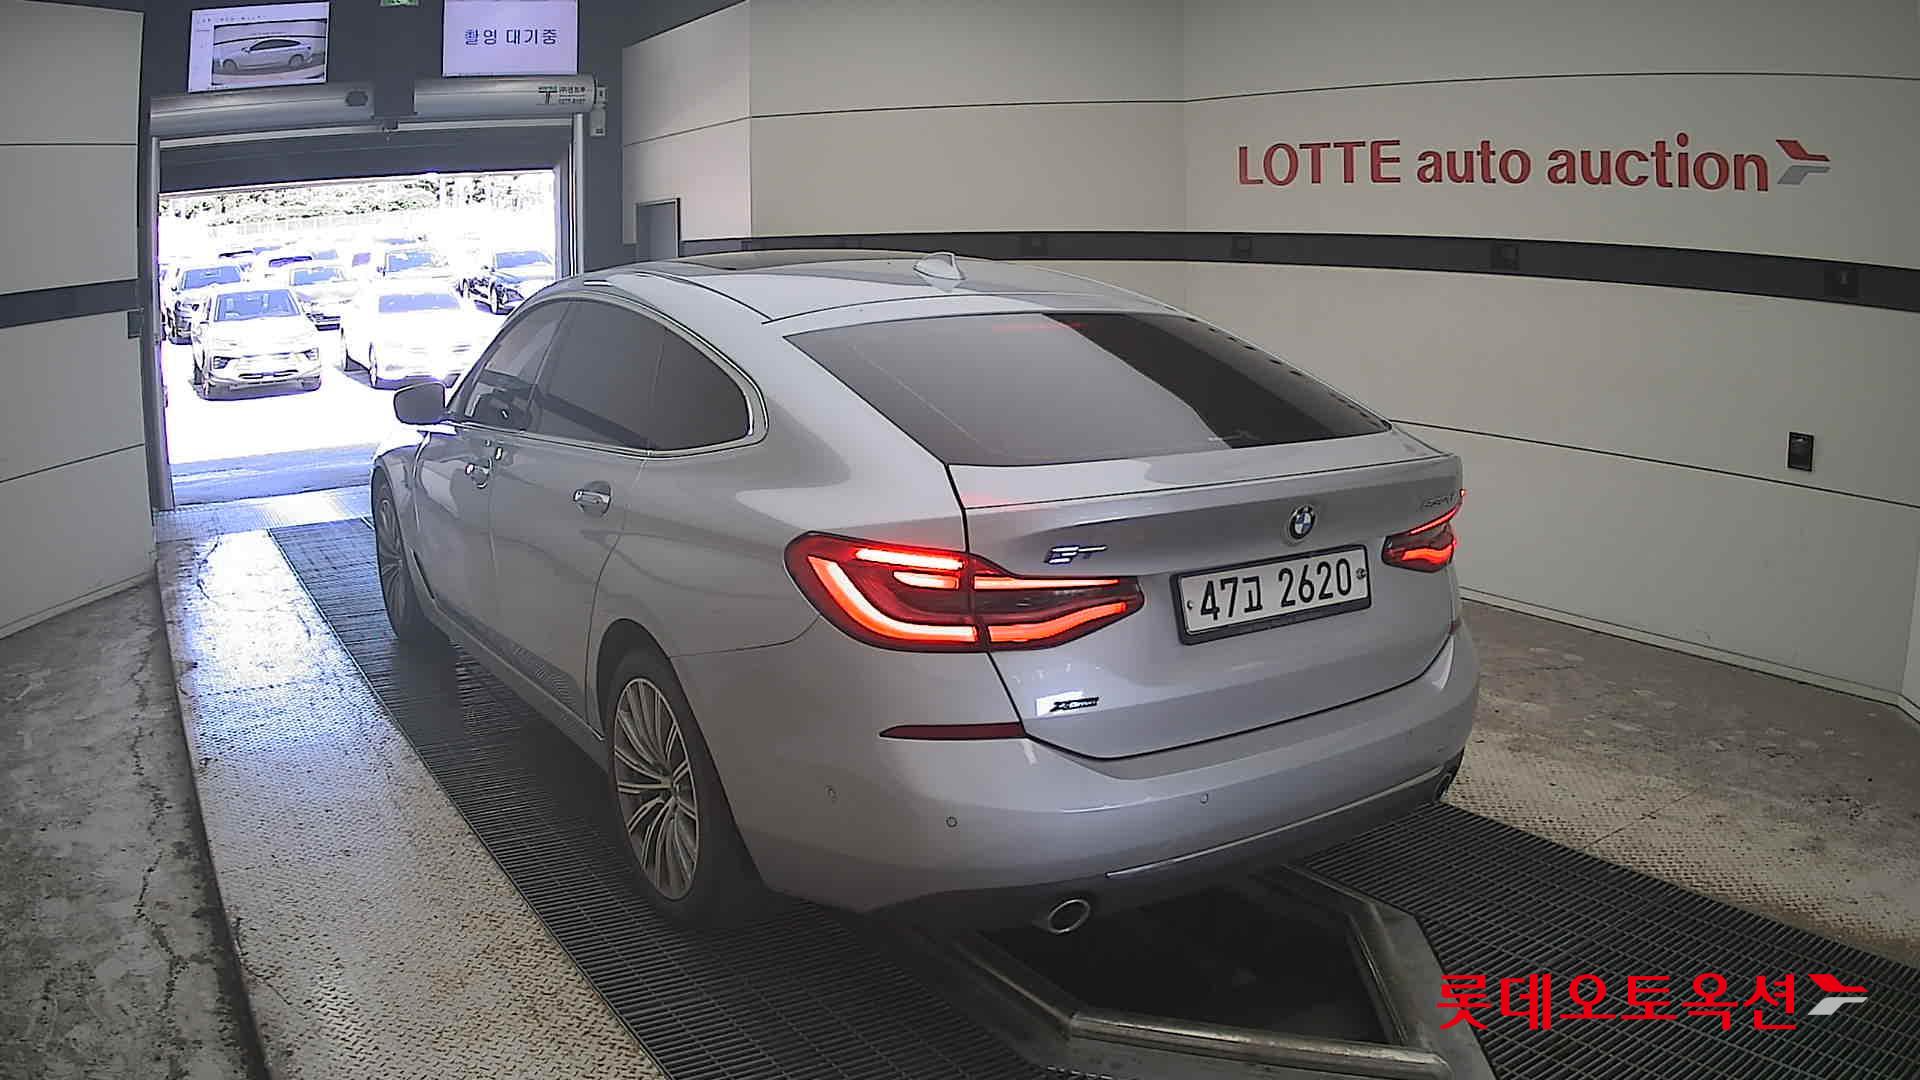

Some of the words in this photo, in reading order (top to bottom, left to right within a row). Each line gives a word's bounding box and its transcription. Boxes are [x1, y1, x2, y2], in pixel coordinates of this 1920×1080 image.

[506, 29, 558, 45] 대기중
[1238, 139, 1401, 186] LOTTE
[1416, 139, 1532, 185] auto
[1547, 132, 1769, 192] auction
[1200, 575, 1263, 621] 47고
[1278, 558, 1352, 608] 2620
